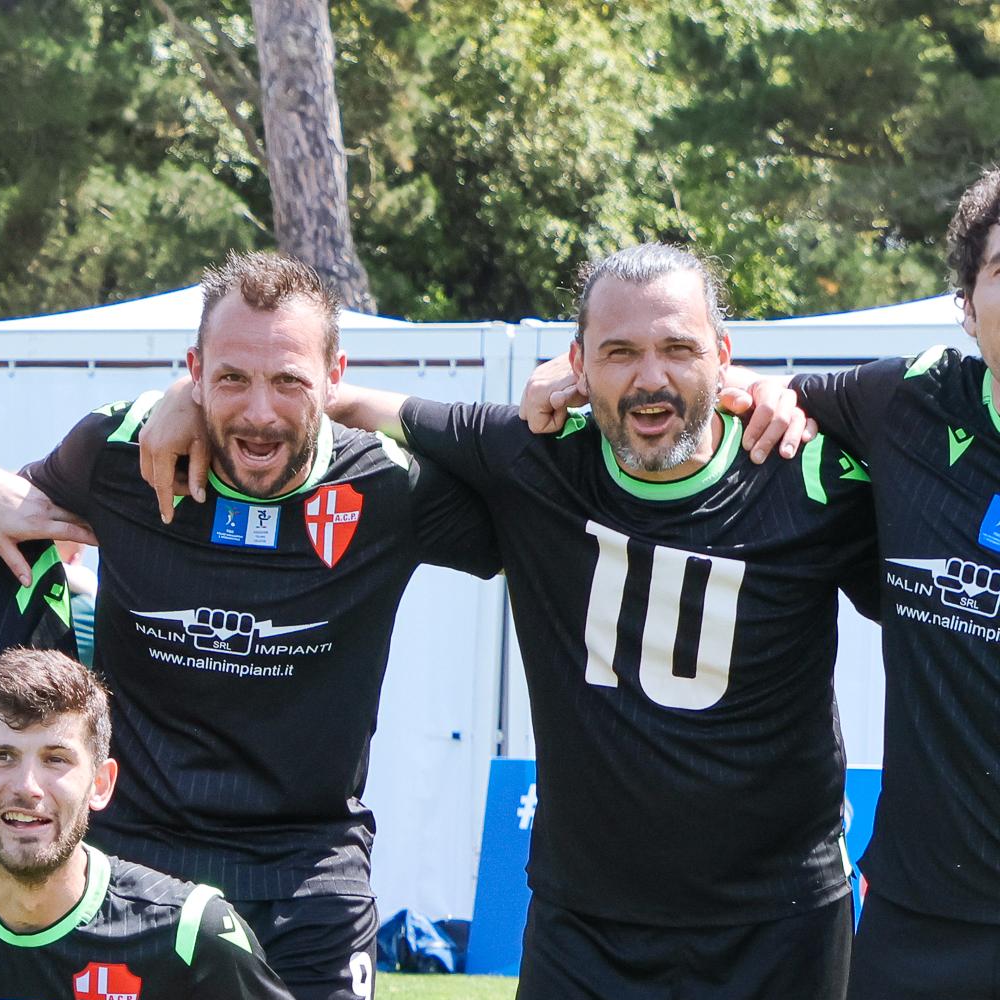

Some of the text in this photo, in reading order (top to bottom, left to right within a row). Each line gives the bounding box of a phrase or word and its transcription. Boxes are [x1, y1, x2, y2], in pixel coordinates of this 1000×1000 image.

[334, 513, 357, 523] A.C.P.
[886, 572, 979, 609] NALIN SRL
[585, 519, 746, 710] 10
[896, 603, 1000, 642] www.nalinimpi
[135, 622, 332, 655] NALIN SRL IMPIANTI
[149, 648, 294, 677] www.nalinimpianti.it
